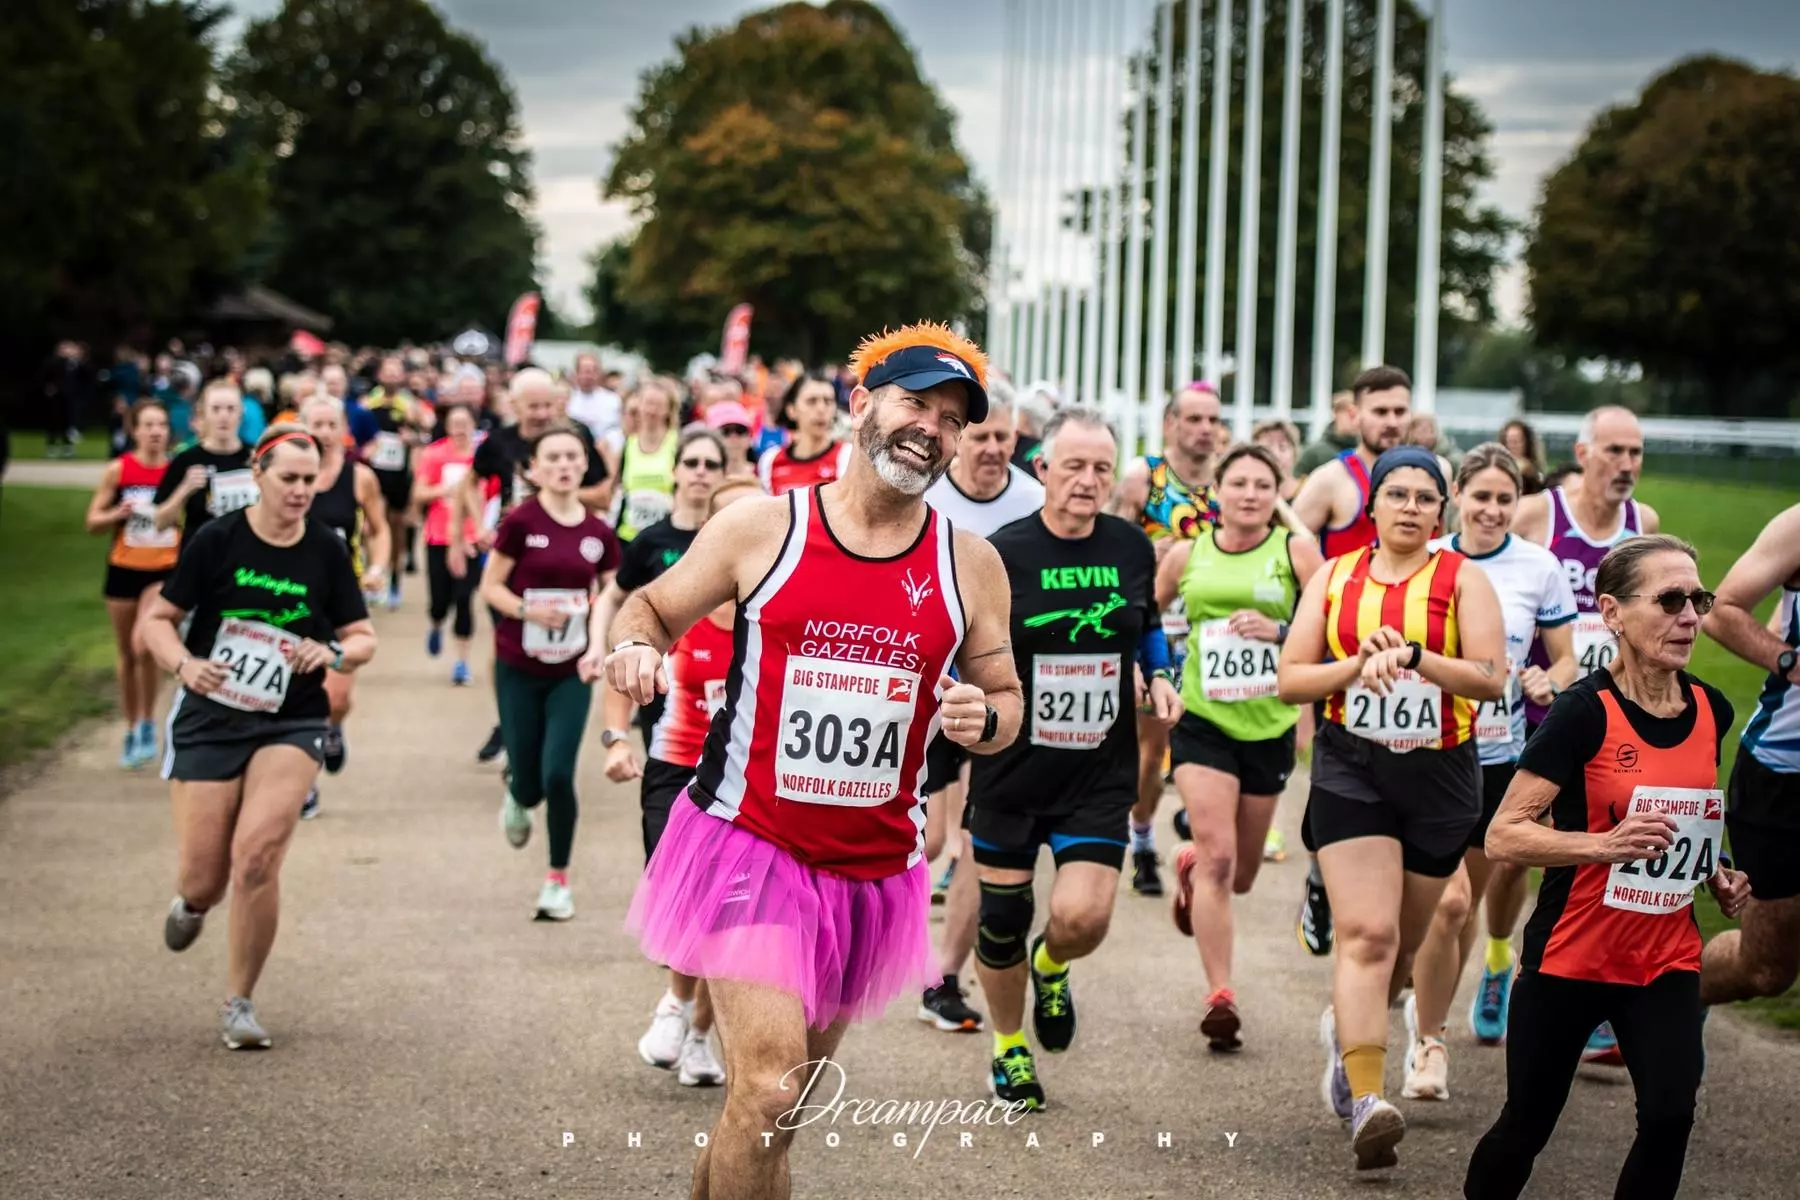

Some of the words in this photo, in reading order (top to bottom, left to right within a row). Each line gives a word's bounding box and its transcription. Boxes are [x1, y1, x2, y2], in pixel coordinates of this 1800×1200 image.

[1040, 567, 1120, 590] KEVIN
[803, 619, 921, 650] NORFOLK
[800, 640, 920, 670] GAZELLES
[1207, 648, 1278, 679] 268A
[219, 647, 284, 695] 247A
[792, 668, 814, 687] BIG
[816, 671, 880, 696] STAMPEDE
[1038, 689, 1115, 723] 321A
[1353, 694, 1438, 729] 216A
[784, 709, 900, 769] 303A
[782, 772, 837, 797] NORFOLK
[837, 780, 892, 799] GAZELLES
[1635, 798, 1652, 813] BIG
[1612, 884, 1661, 906] NORFOLK
